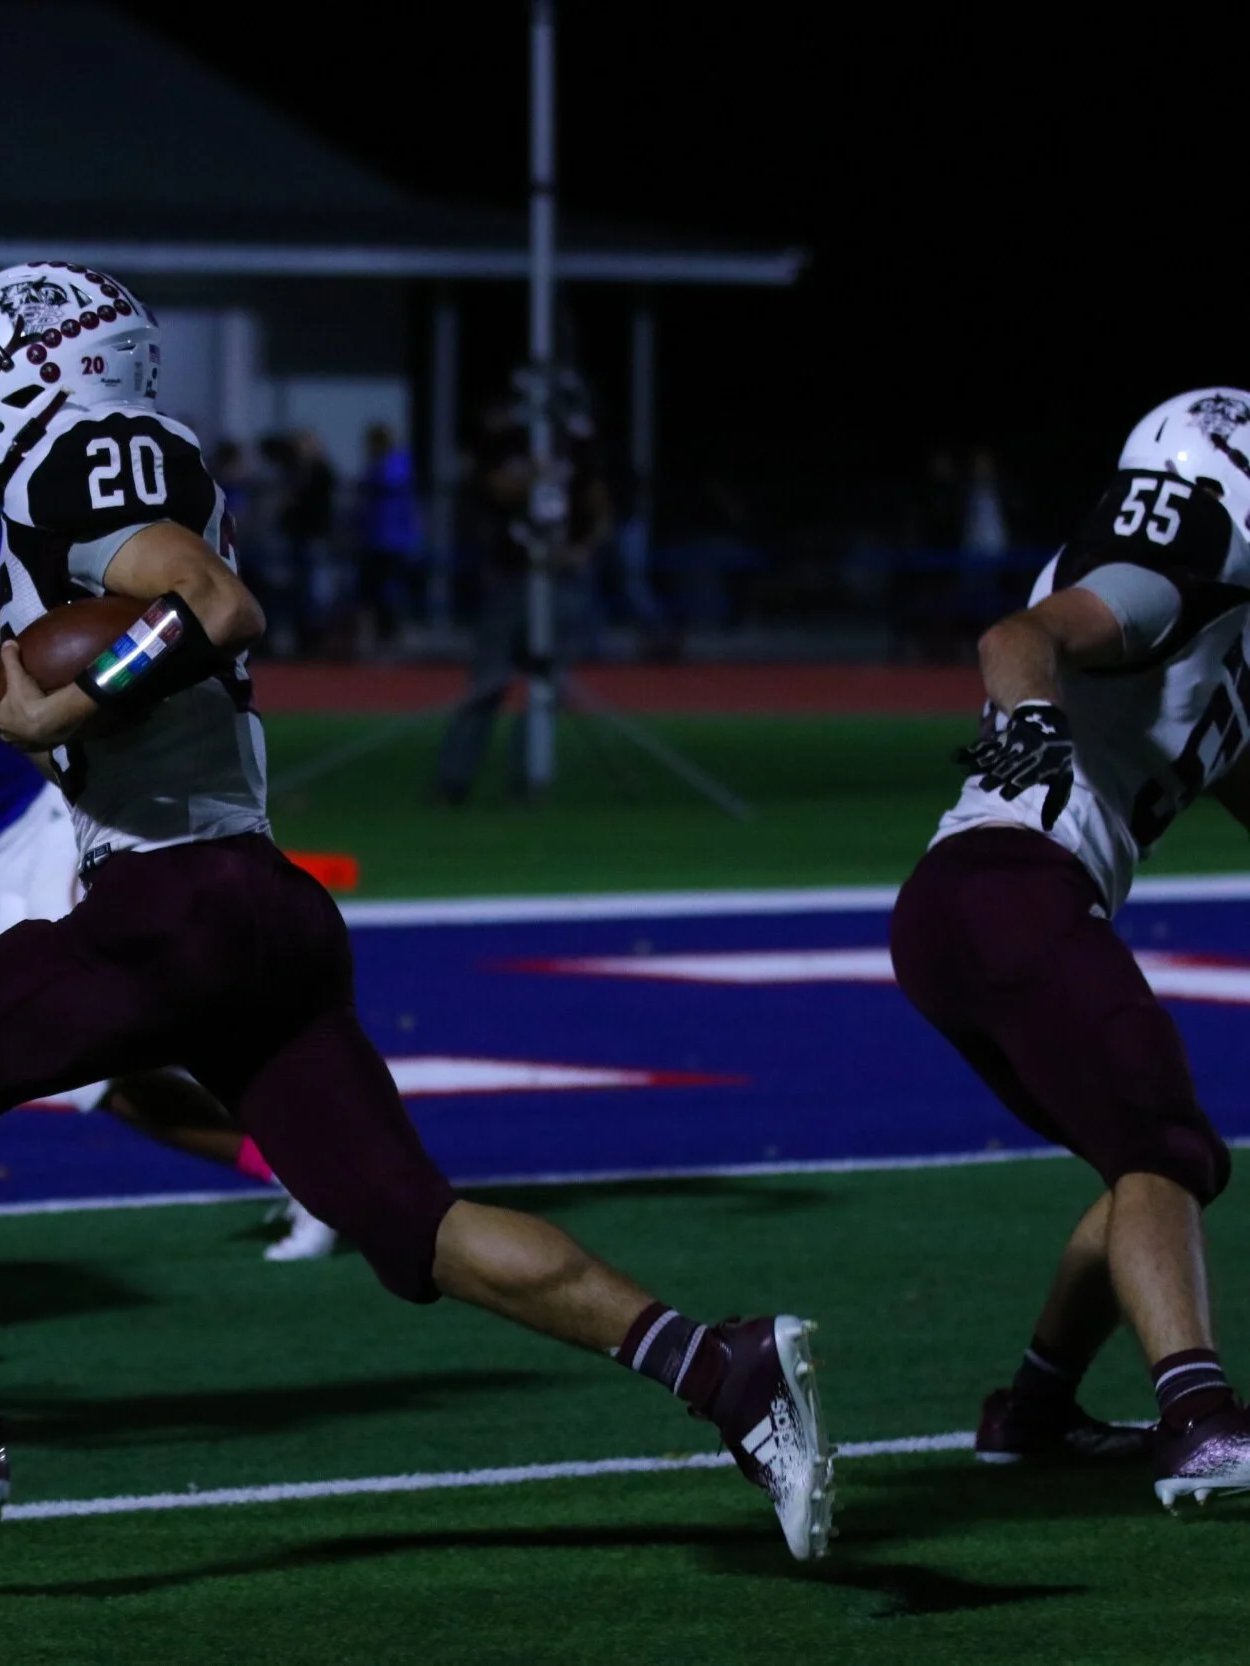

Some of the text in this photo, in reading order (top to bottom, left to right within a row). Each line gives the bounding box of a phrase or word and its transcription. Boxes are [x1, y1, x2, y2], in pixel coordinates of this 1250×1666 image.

[81, 356, 105, 375] 20
[86, 435, 168, 510] 20
[1113, 477, 1194, 546] 55
